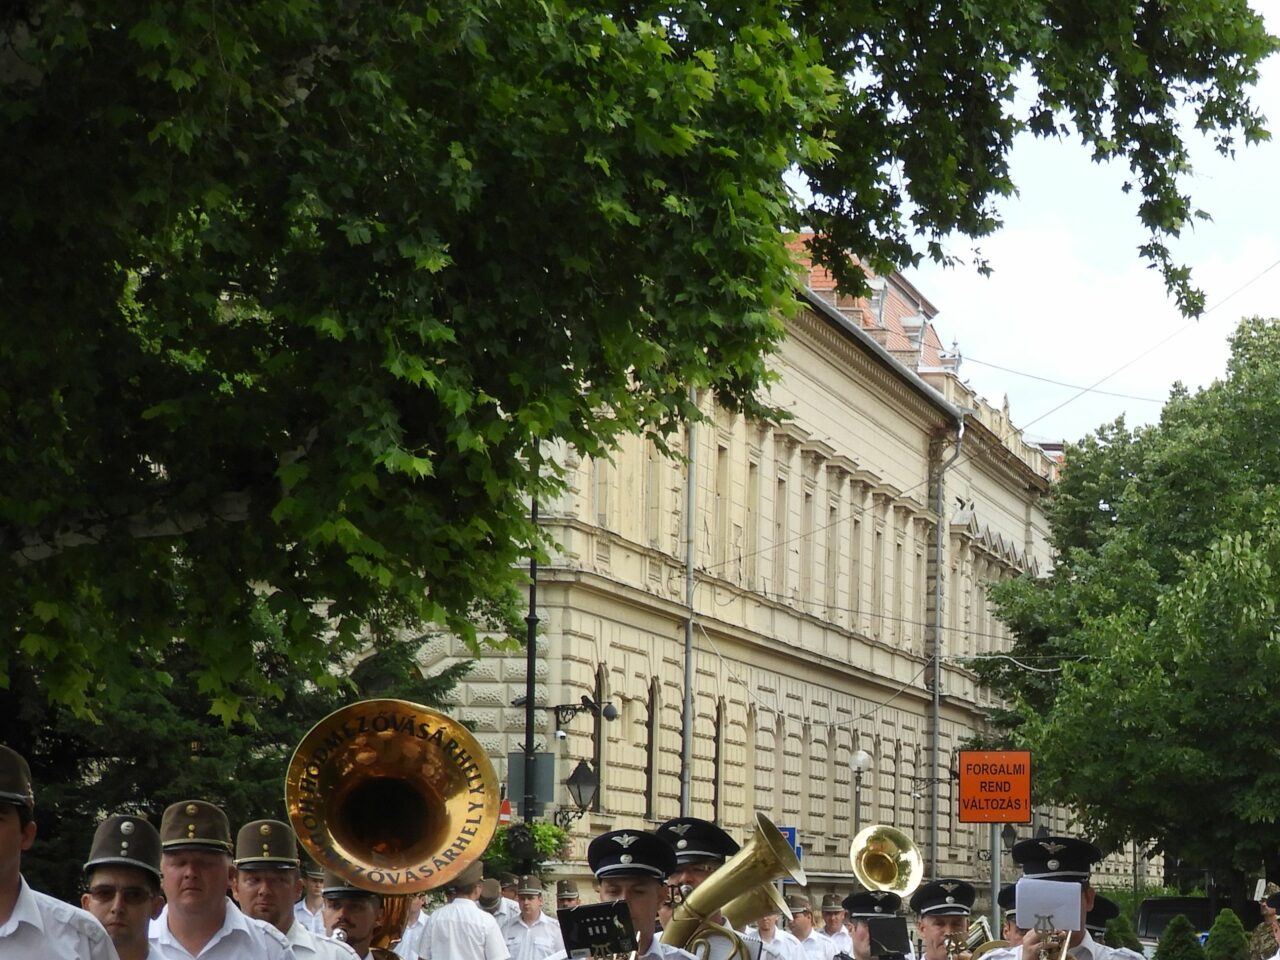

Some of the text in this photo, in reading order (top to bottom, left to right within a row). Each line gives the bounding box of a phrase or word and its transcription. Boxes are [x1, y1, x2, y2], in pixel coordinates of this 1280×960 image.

[966, 763, 1026, 776] FORGALMI
[980, 781, 1011, 793] REND
[962, 796, 1021, 811] VÁLTOZÁS
